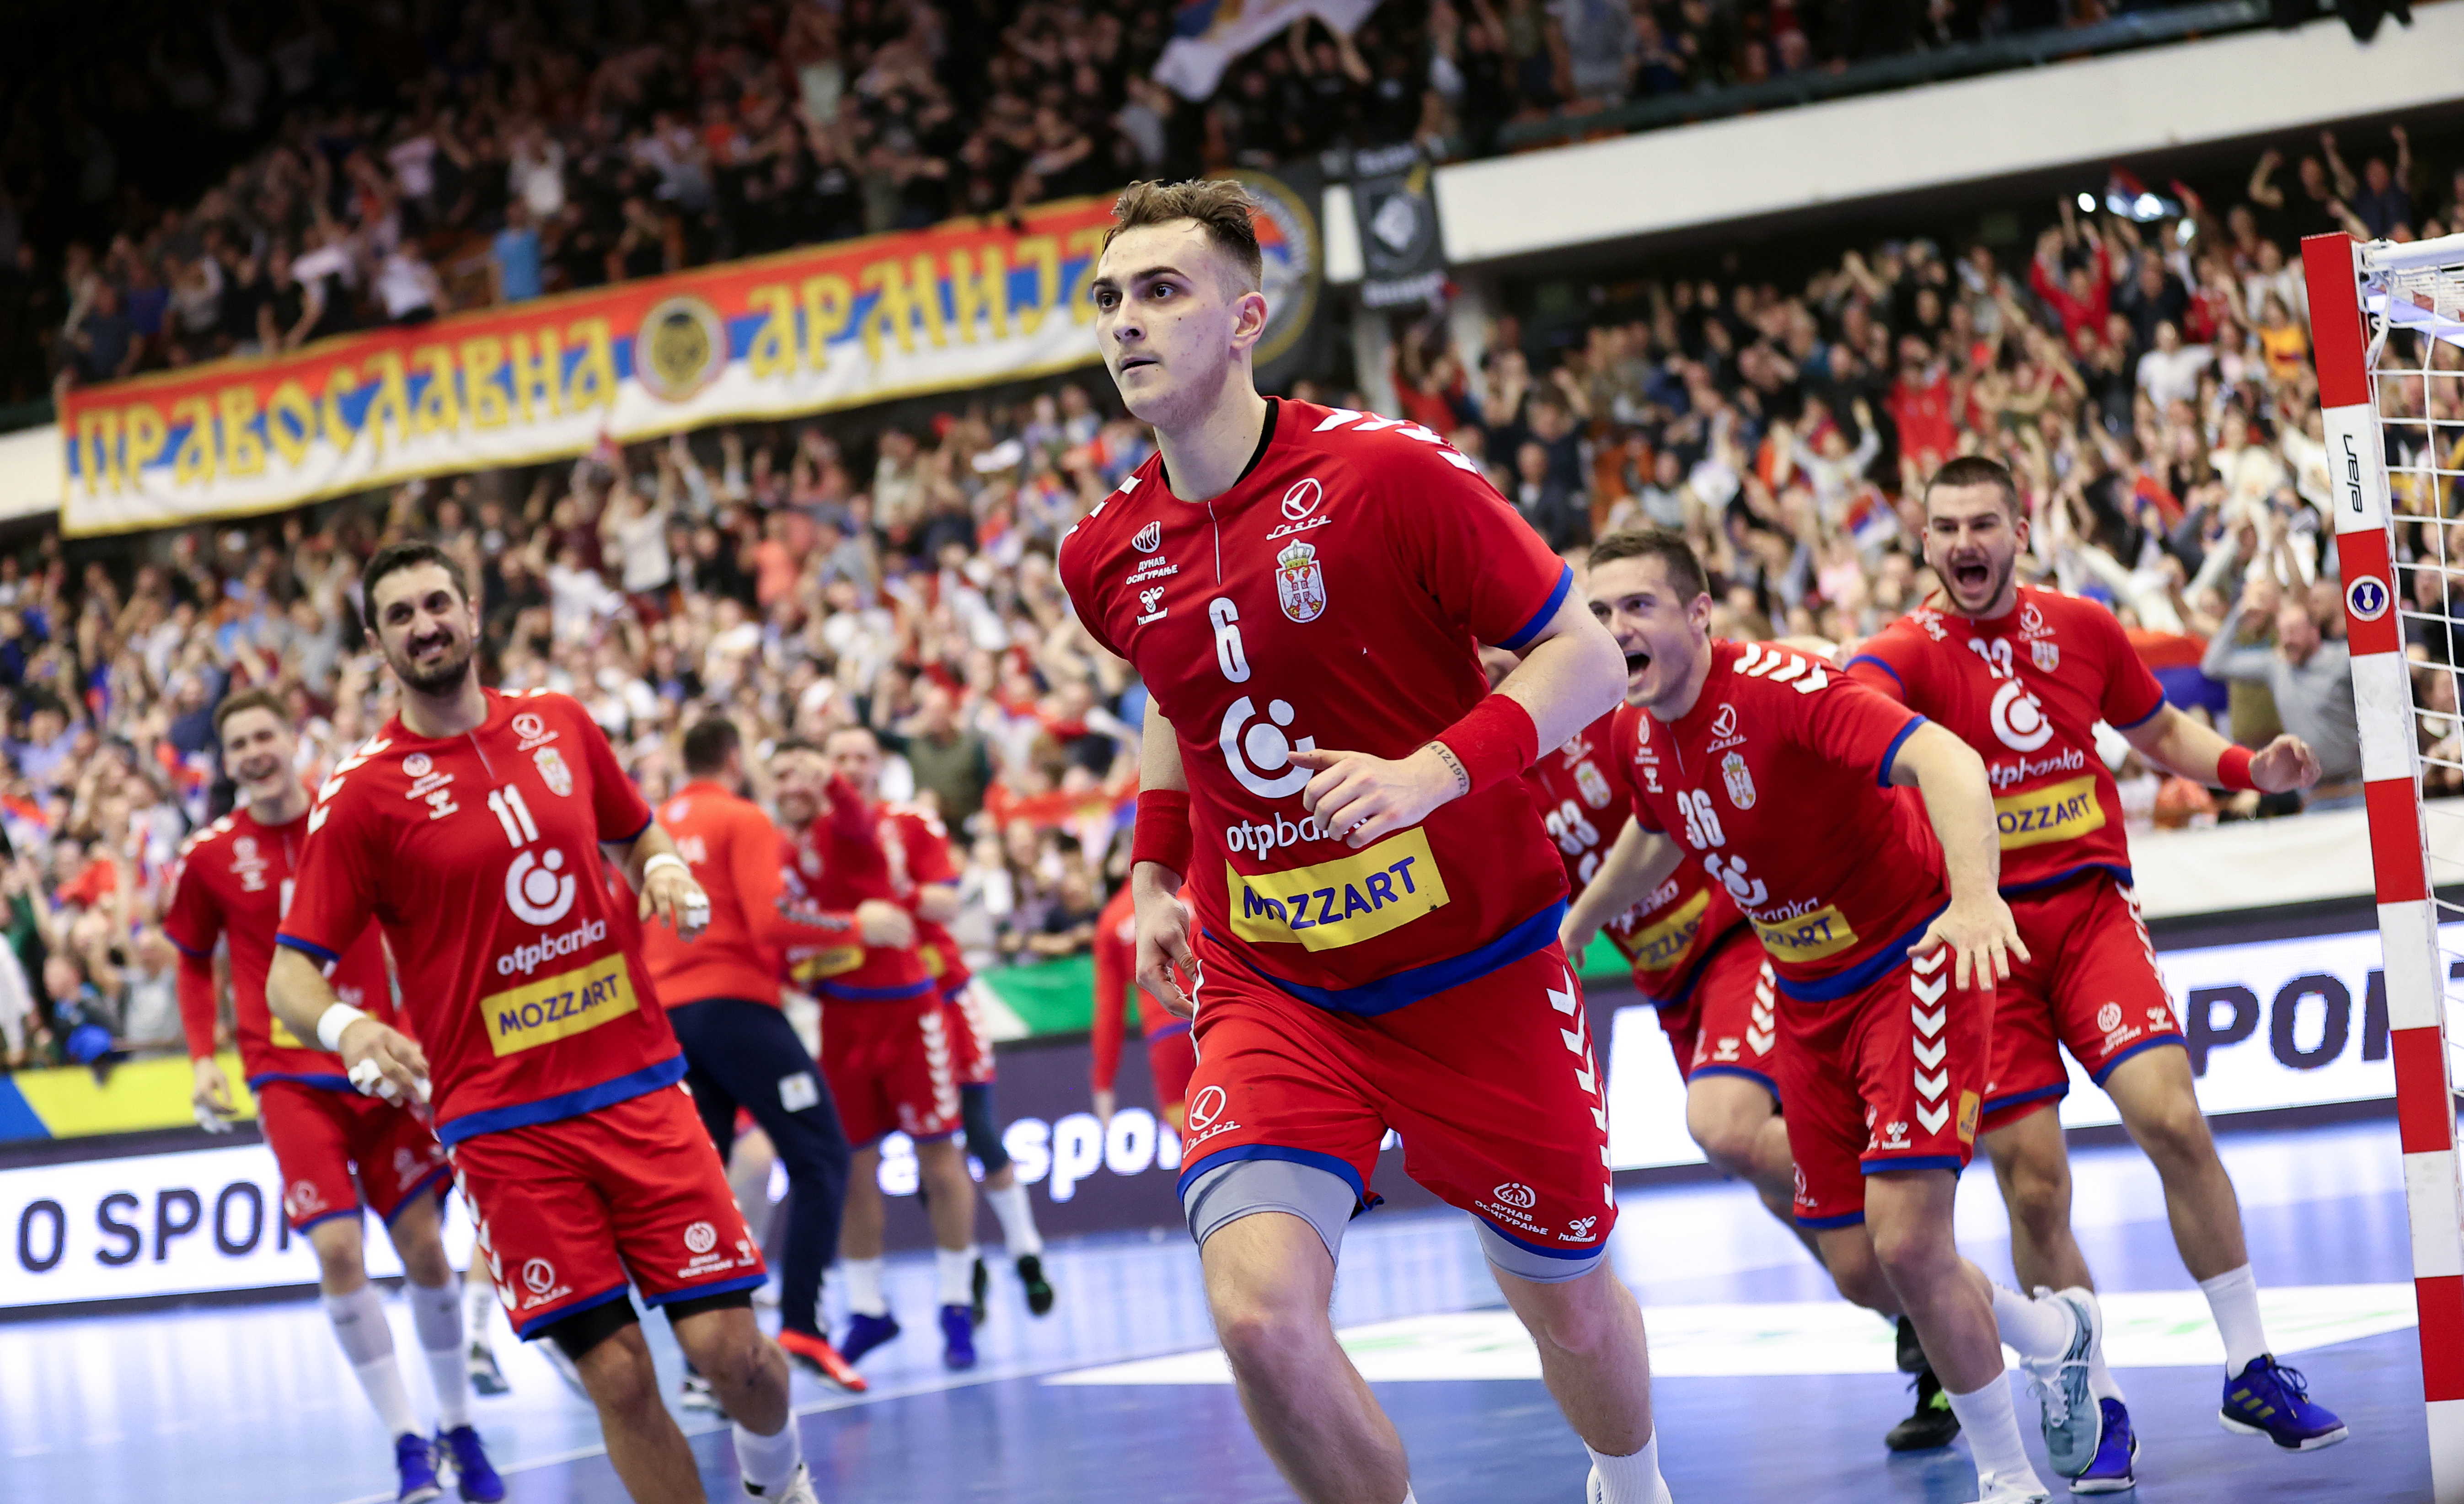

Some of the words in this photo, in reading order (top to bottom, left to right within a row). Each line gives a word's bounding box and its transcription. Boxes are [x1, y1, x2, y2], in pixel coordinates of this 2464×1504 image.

[2343, 434, 2363, 513] elan
[1265, 515, 1333, 541] Lasta
[1125, 564, 1178, 585] ОСИГУРАЊЕ
[1138, 556, 1166, 573] ДУНАВ
[1136, 607, 1168, 626] hummel
[1209, 597, 1251, 683] 6
[487, 783, 539, 849] 11
[1227, 812, 1369, 861] otpba
[1545, 798, 1601, 856] 33
[1677, 788, 1726, 850] 36
[1998, 793, 2090, 834] OZZART
[1243, 856, 1415, 930] MOZZART
[498, 973, 617, 1036] MOZZART
[96, 1181, 290, 1266] SPO
[1474, 1199, 1549, 1235] ОСИГУРАЊЕ
[1490, 1202, 1533, 1222] ДУНАВ
[1558, 1232, 1597, 1243] hummel
